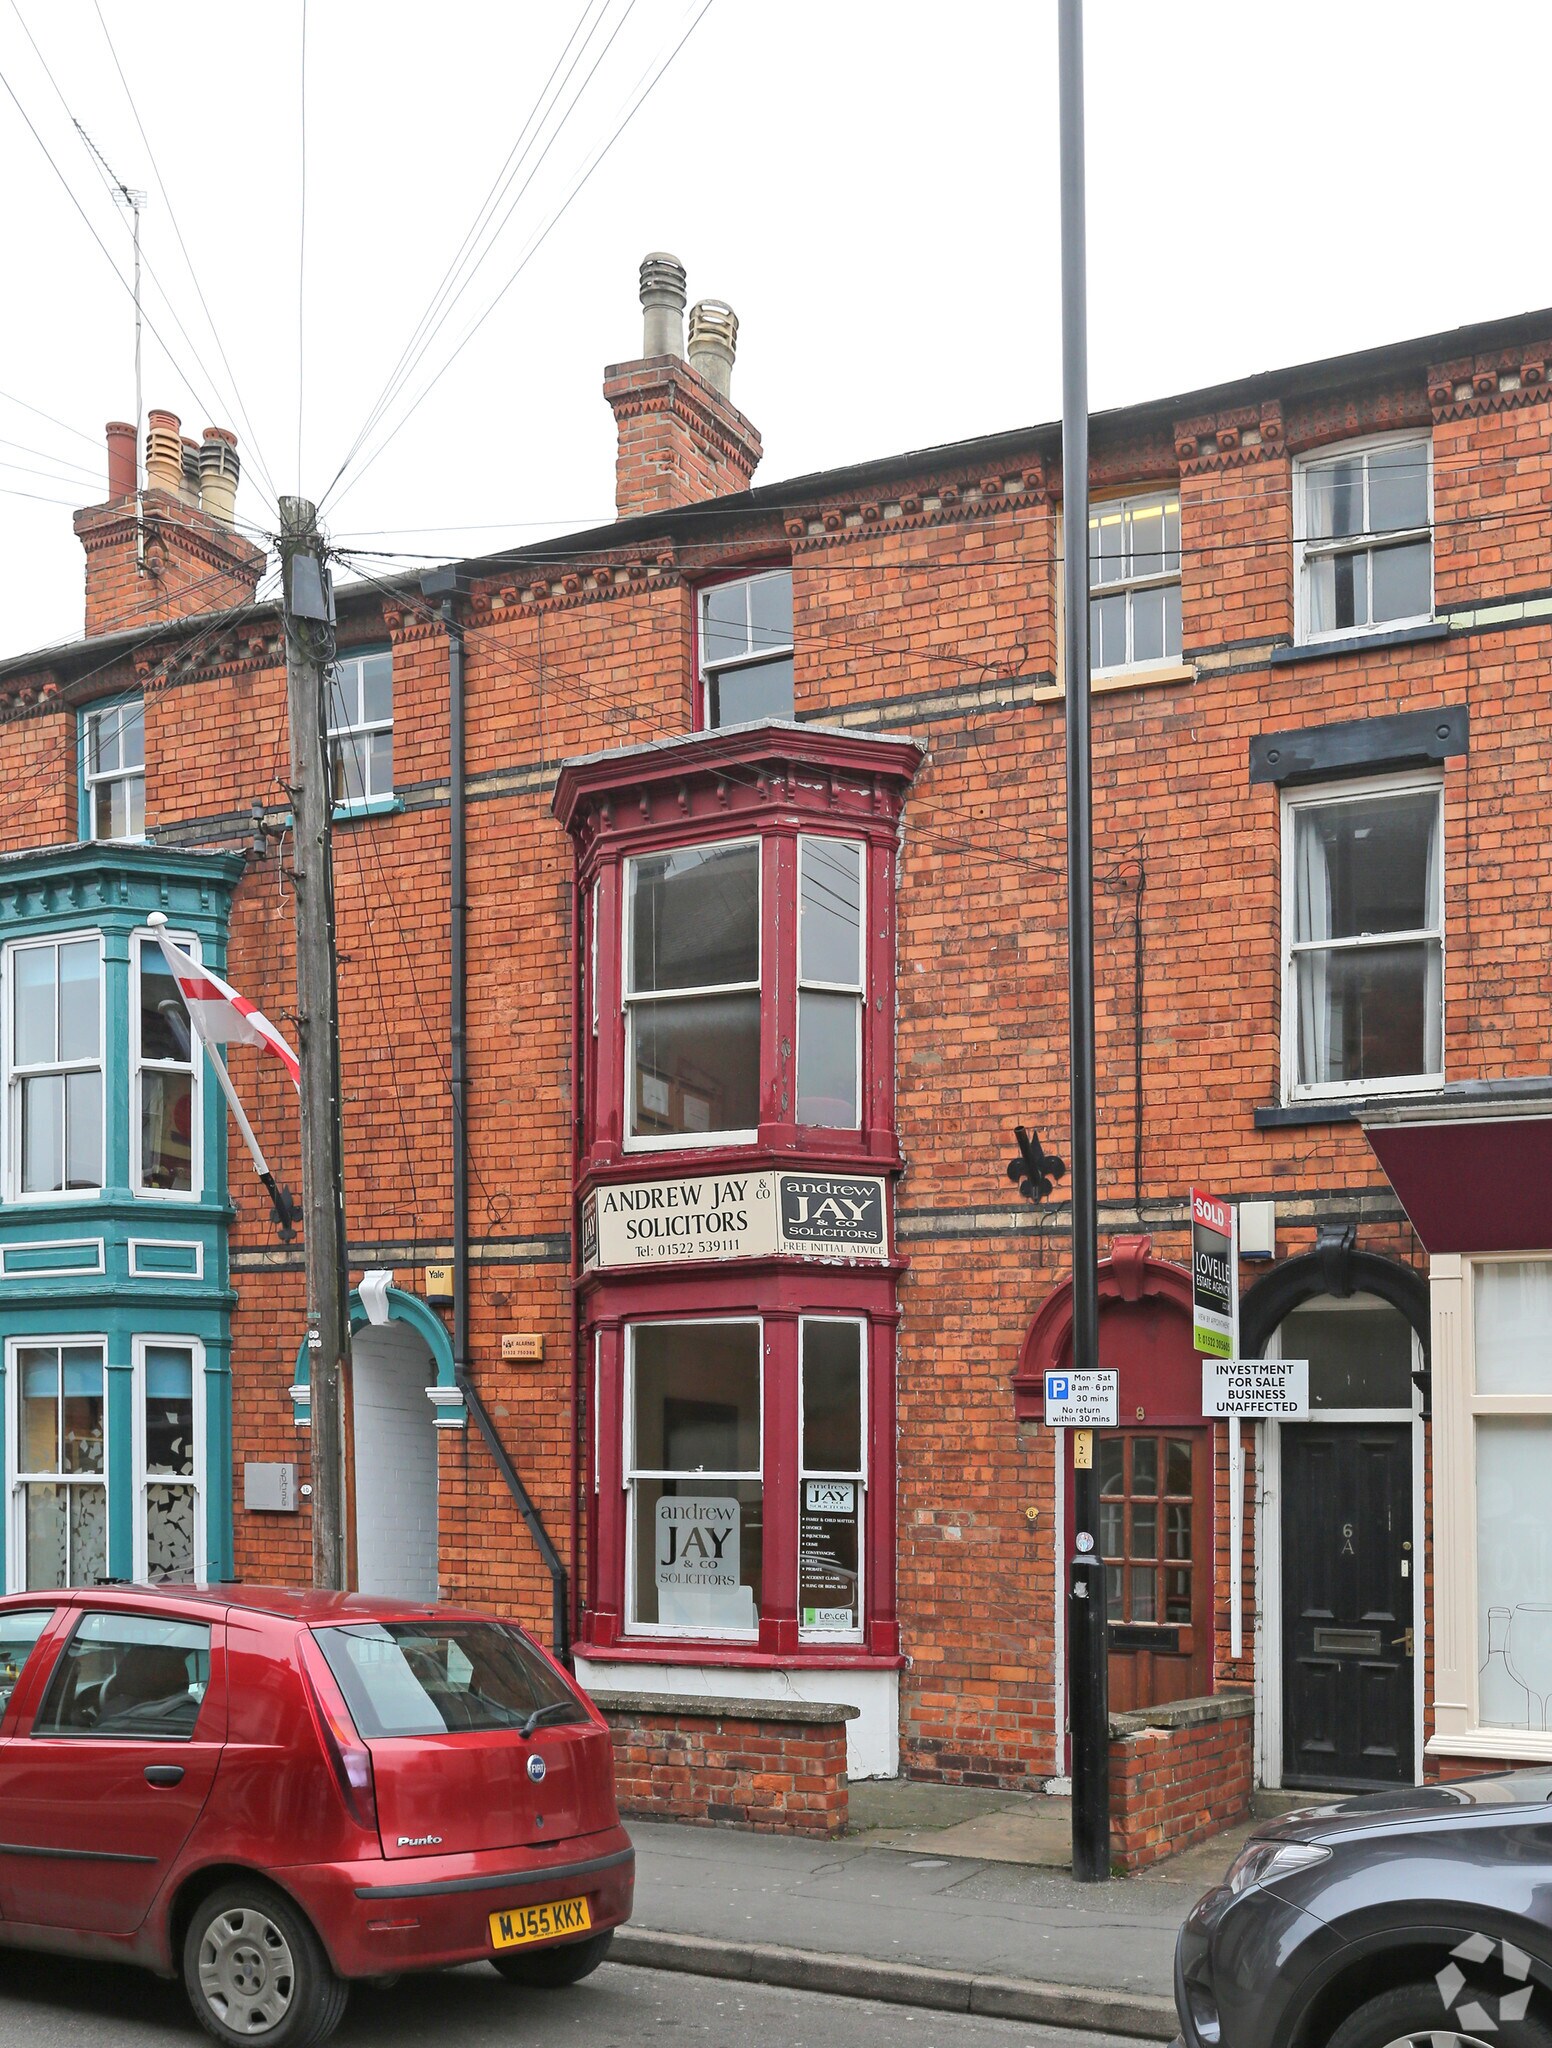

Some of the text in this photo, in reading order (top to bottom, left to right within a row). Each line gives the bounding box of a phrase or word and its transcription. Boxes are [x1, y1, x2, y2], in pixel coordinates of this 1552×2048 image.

[758, 1178, 767, 1189] &
[786, 1182, 875, 1197] andrew
[603, 1184, 702, 1213] ANDREW
[711, 1180, 748, 1210] JAY
[755, 1189, 771, 1200] CO
[788, 1196, 875, 1225] JAY
[1195, 1197, 1225, 1227] SOLD
[626, 1210, 748, 1240] SOLICITORS
[835, 1220, 858, 1228] CO
[789, 1226, 878, 1239] SOLICITORS
[635, 1239, 739, 1257] Tel: 01522 539111
[783, 1242, 885, 1255] FREE INITIAL ADVICE
[1196, 1251, 1231, 1284] LOVELLE
[429, 1270, 445, 1279] Yale
[1196, 1274, 1212, 1290] ESTATE
[1216, 1365, 1294, 1375] INVESTMENT
[1052, 1379, 1066, 1398] P
[1228, 1378, 1286, 1387] FOR SALE
[1076, 1394, 1109, 1402] 30 mins
[1228, 1390, 1286, 1400] BUSINESS
[1136, 1406, 1145, 1420] 8
[1216, 1402, 1298, 1412] UNAFFECTED
[1078, 1433, 1086, 1442] C
[1079, 1446, 1084, 1455] 2
[280, 1467, 288, 1507] optima
[810, 1490, 850, 1503] JAY
[661, 1503, 735, 1520] andrew
[1342, 1523, 1353, 1538] 6
[661, 1526, 733, 1566] JAY
[1341, 1539, 1355, 1555] A
[684, 1560, 718, 1569] & CO
[660, 1572, 735, 1586] SOLICITORS
[820, 1611, 849, 1621] Lexcel
[531, 1764, 544, 1774] FIAT
[398, 1835, 443, 1847] Punto
[499, 1900, 585, 1941] MJ55 KKX
